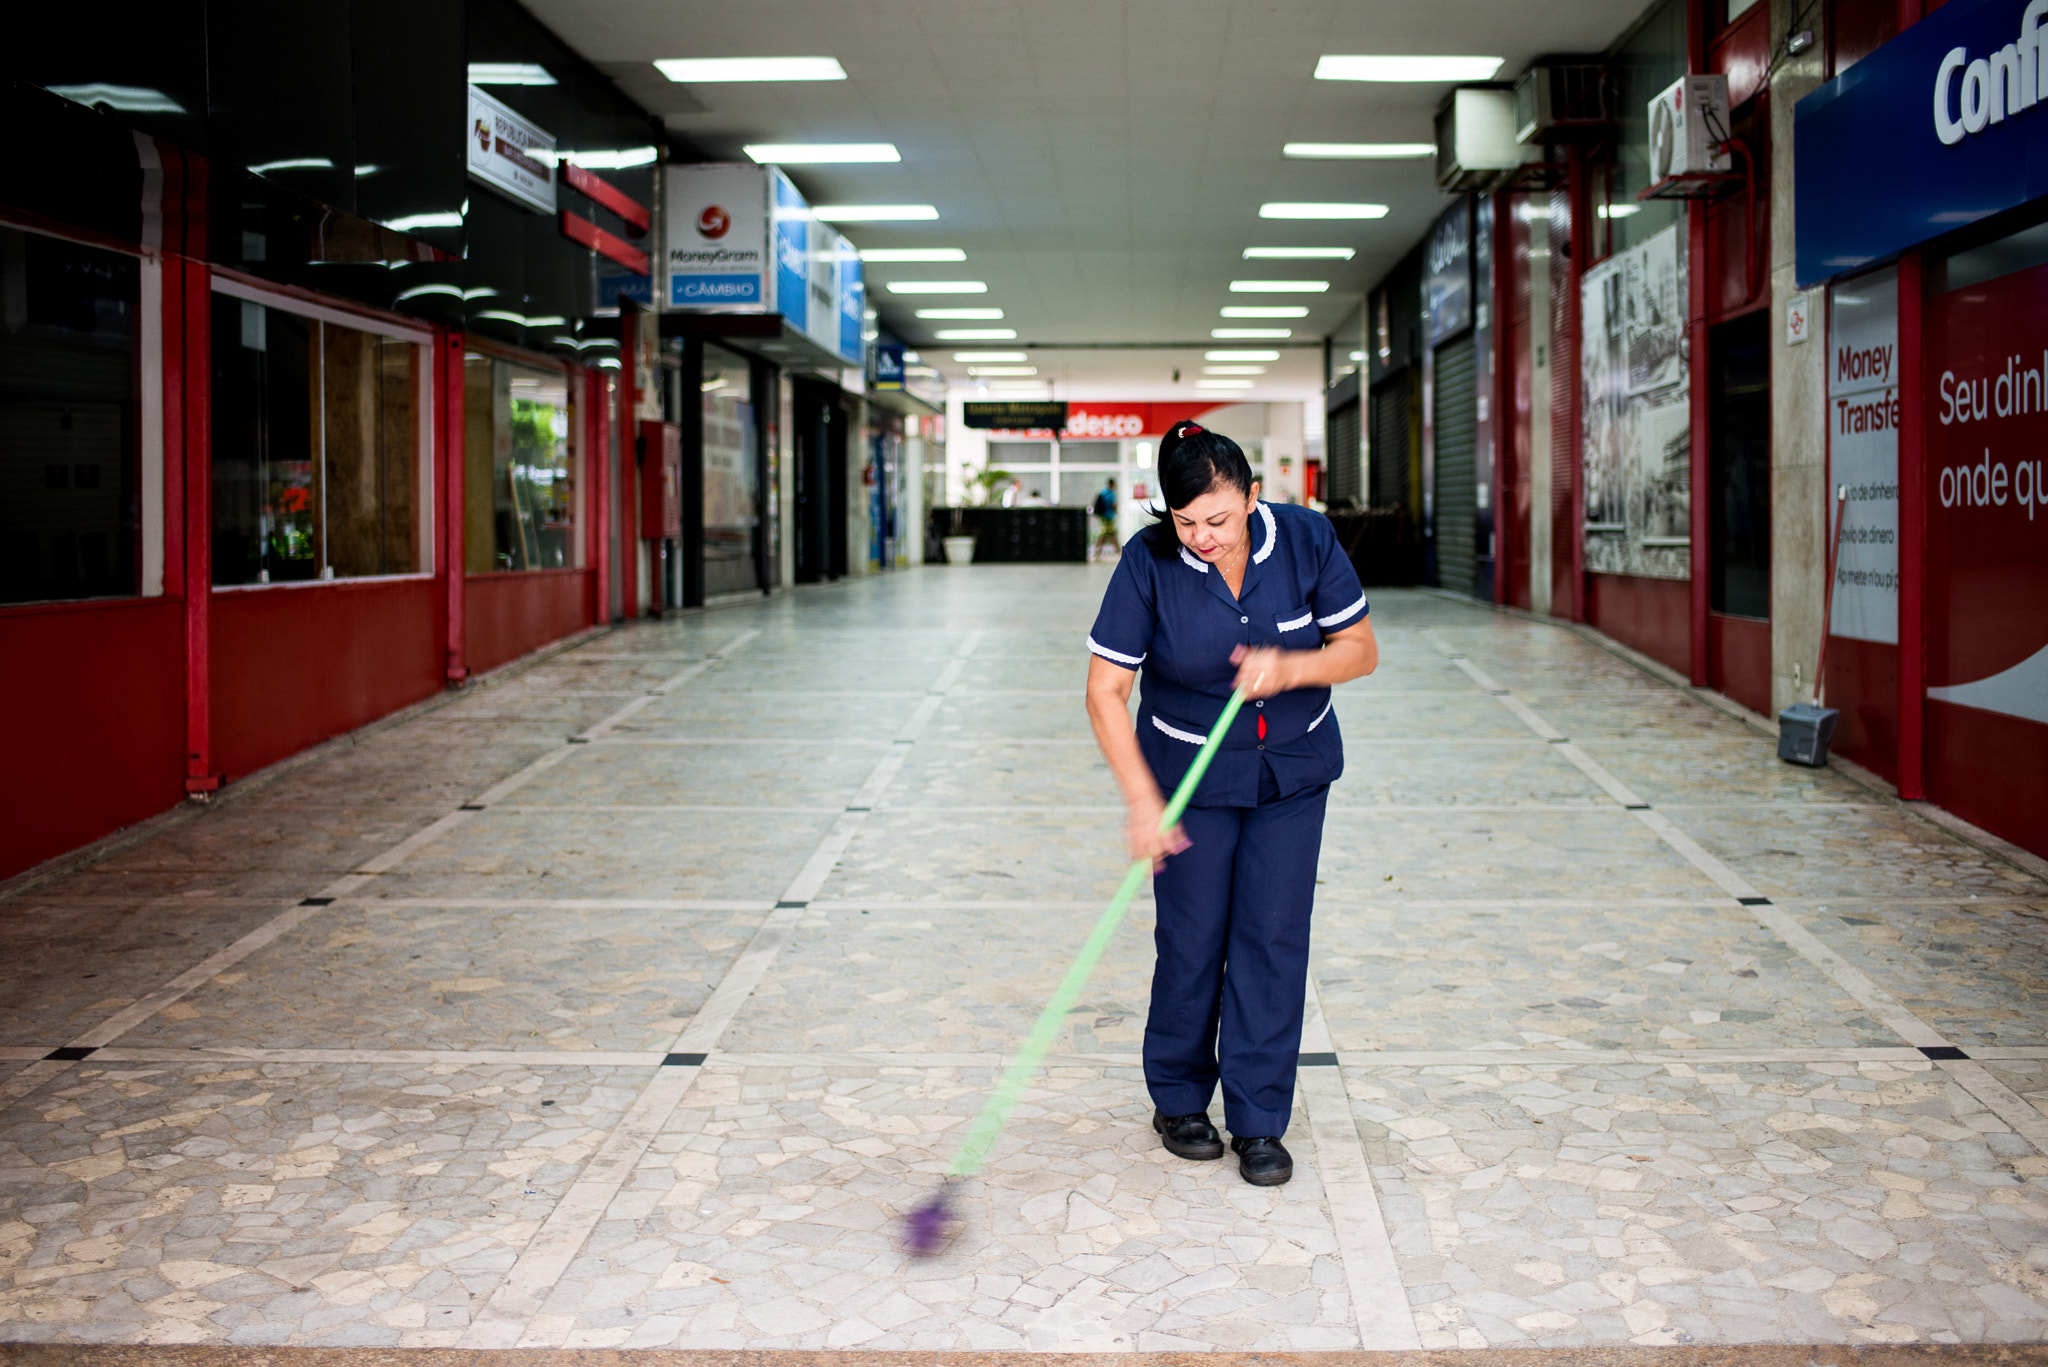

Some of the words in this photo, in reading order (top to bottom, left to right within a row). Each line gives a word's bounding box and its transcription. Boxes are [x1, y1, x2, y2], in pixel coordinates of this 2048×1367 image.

[671, 250, 759, 265] MoneyGram
[684, 281, 755, 297] CÂMBIO
[1838, 344, 1893, 383] Money
[1837, 388, 1898, 435] Transfe
[1940, 370, 1988, 425] Seu
[1067, 410, 1144, 437] desco
[1940, 447, 2008, 508] onde
[2015, 460, 2048, 521] qu
